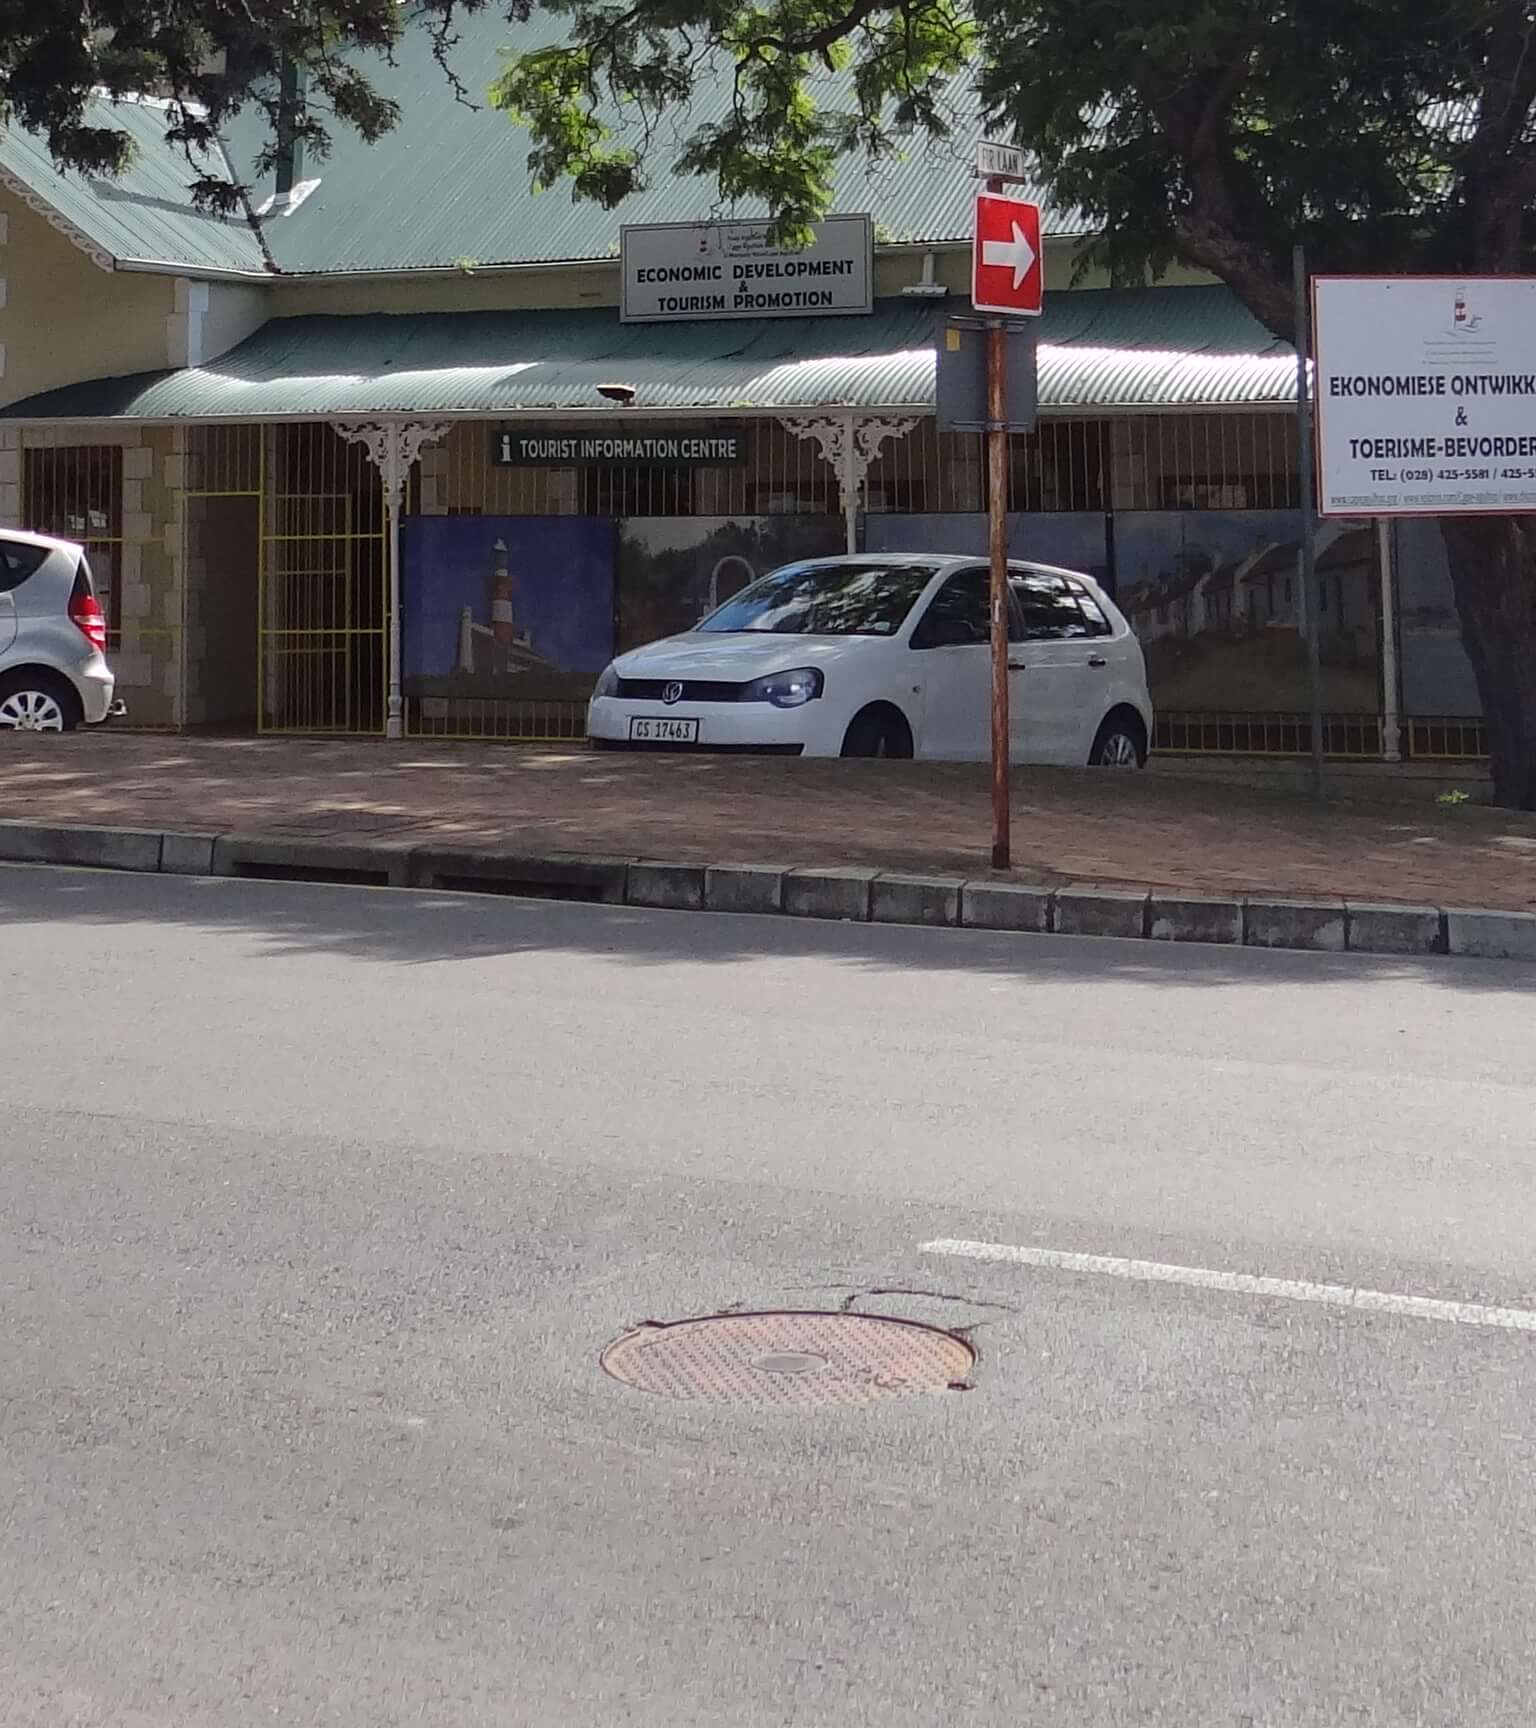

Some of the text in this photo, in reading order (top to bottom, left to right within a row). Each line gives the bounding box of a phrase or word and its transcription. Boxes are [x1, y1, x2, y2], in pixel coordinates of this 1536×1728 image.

[997, 151, 1018, 175] LAAN
[637, 259, 854, 284] ECONOMIC DEVELOPMENT
[738, 279, 749, 293] &
[657, 290, 833, 312] TOURISM PROMOTION
[1330, 375, 1446, 397] EKONOMIESE
[1454, 406, 1468, 427] &
[519, 439, 577, 458] TOURIST
[580, 439, 678, 458] INFORMATION
[681, 439, 737, 458] CENTRE
[1370, 469, 1397, 481] TEL:
[1399, 468, 1434, 484] (028)
[1436, 468, 1490, 480] 425-5581
[636, 721, 691, 739] CS 17463
